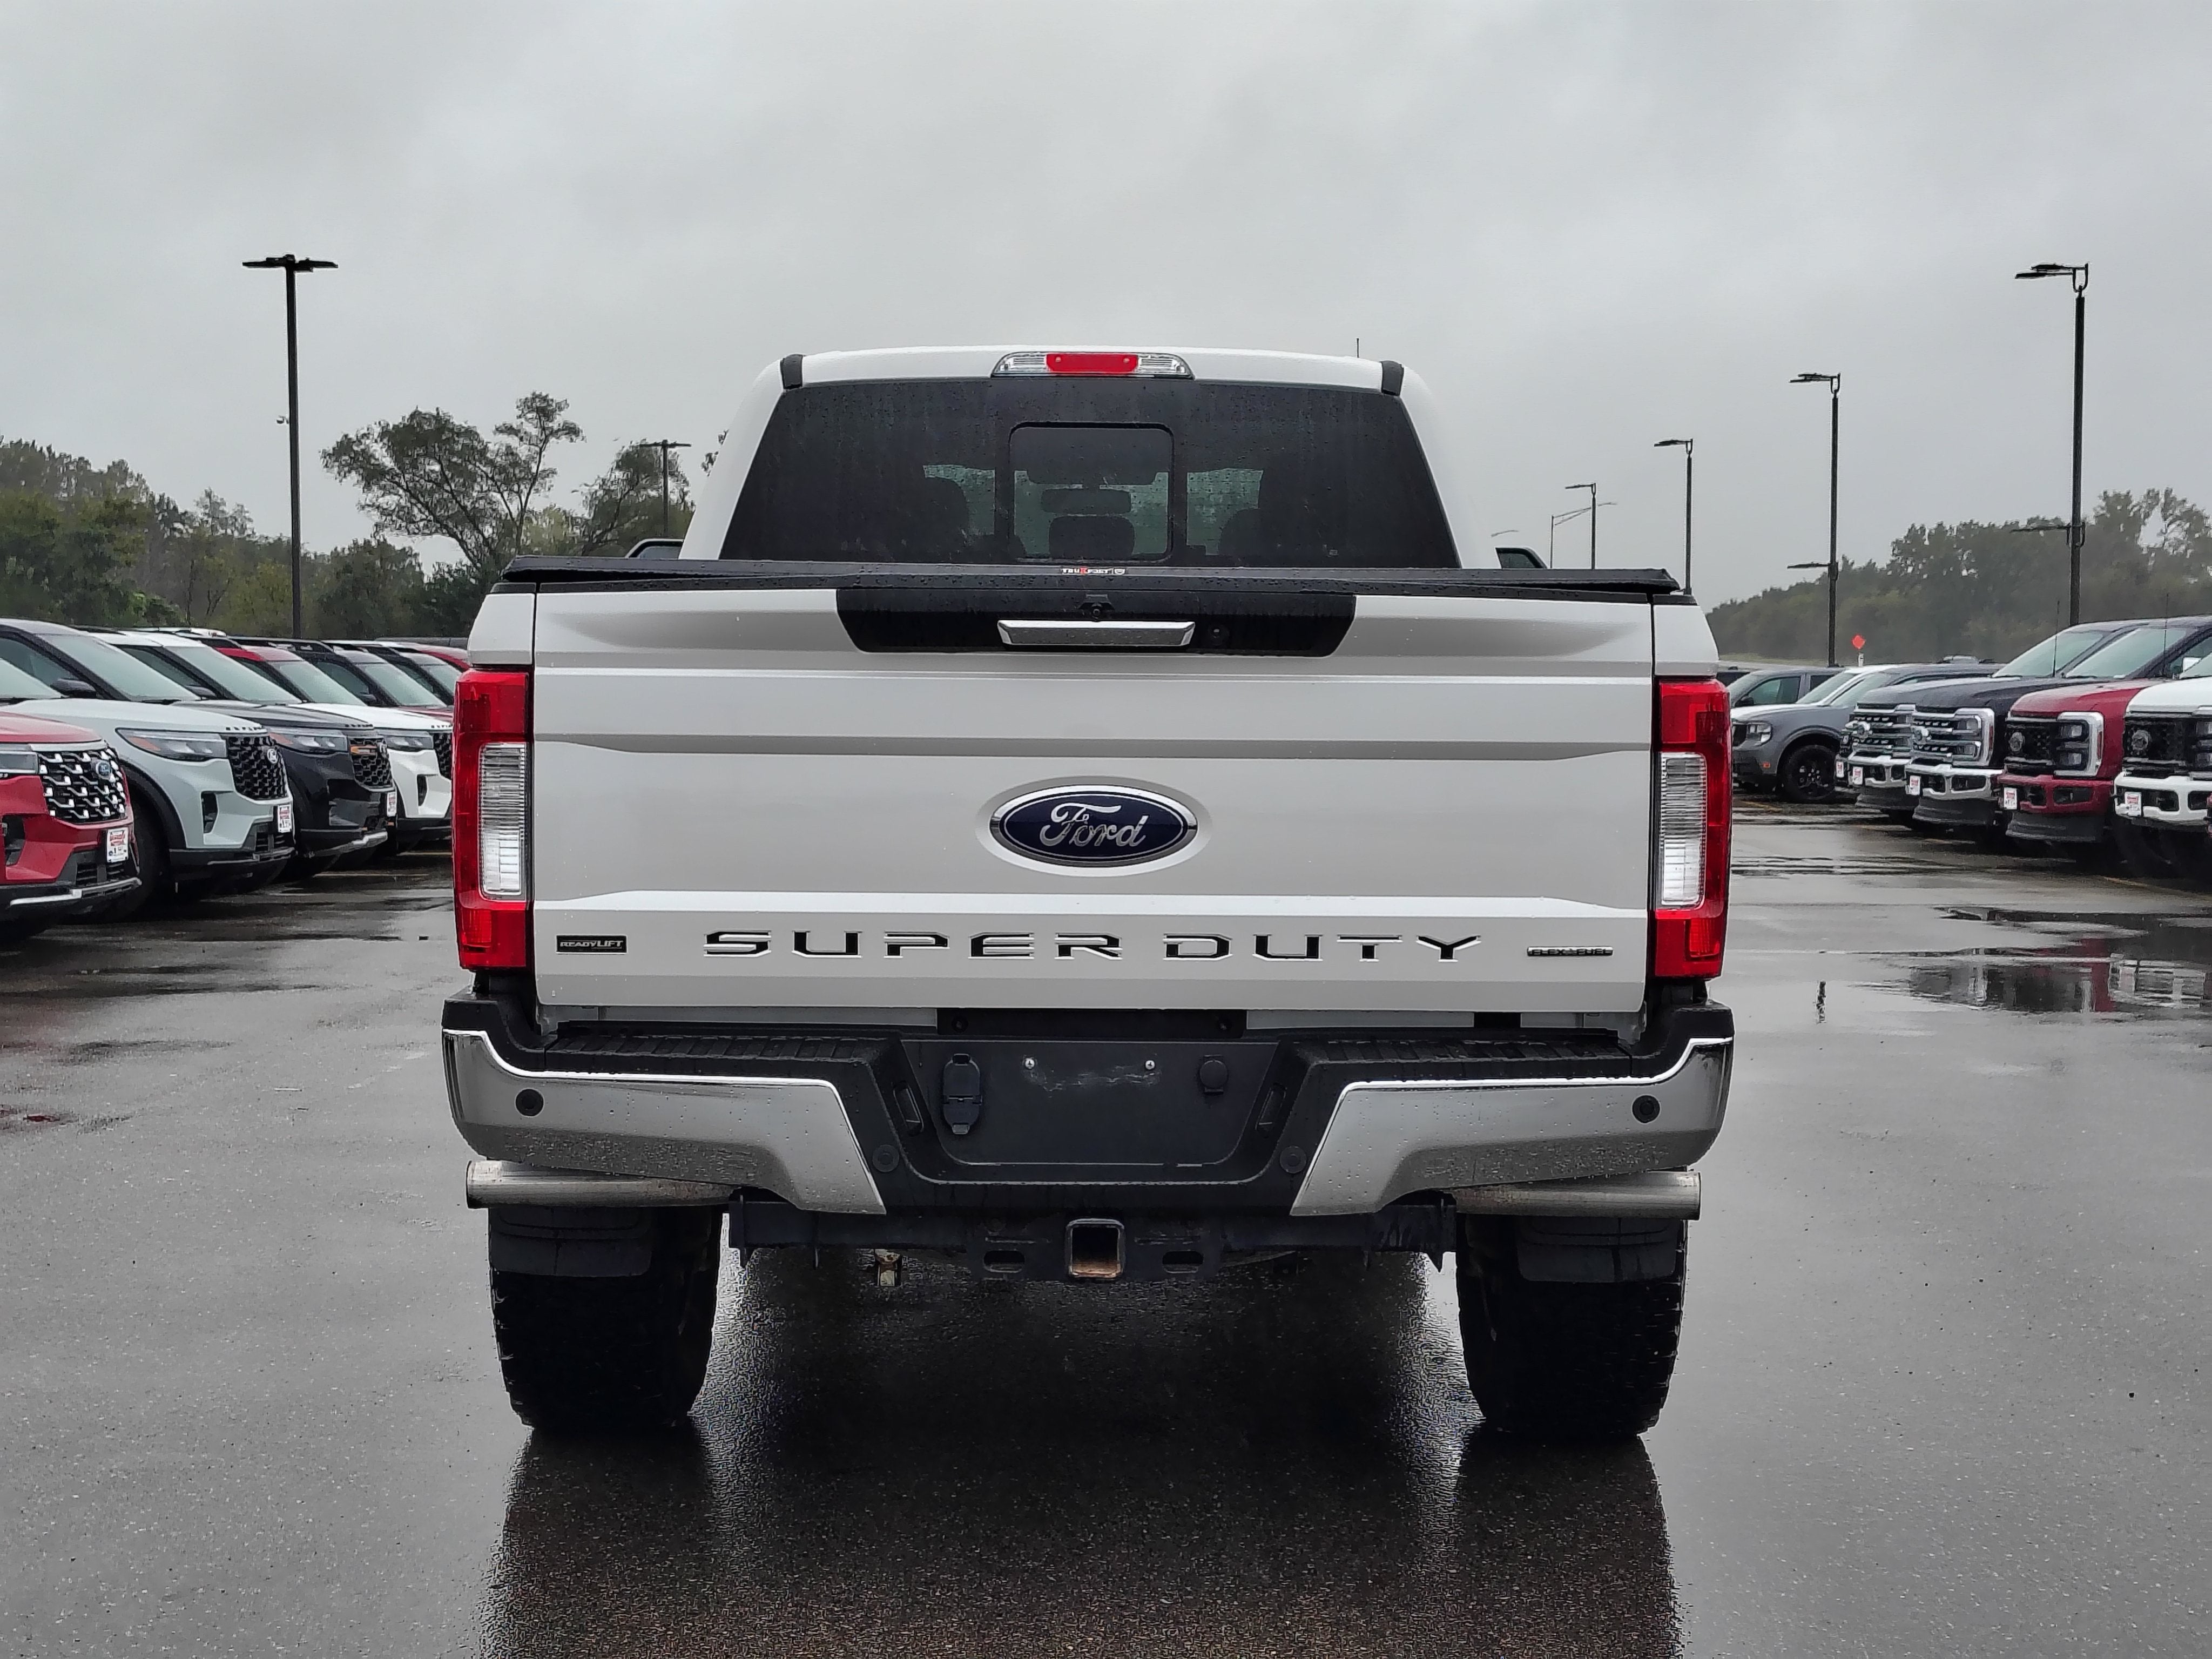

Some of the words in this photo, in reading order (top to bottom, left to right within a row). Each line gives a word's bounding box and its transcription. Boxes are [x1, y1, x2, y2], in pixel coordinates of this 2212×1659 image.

[1039, 801, 1149, 847] Ford
[559, 940, 624, 948] READYLIFT
[703, 930, 1124, 961] SUPER
[1163, 932, 1483, 963] DUTY
